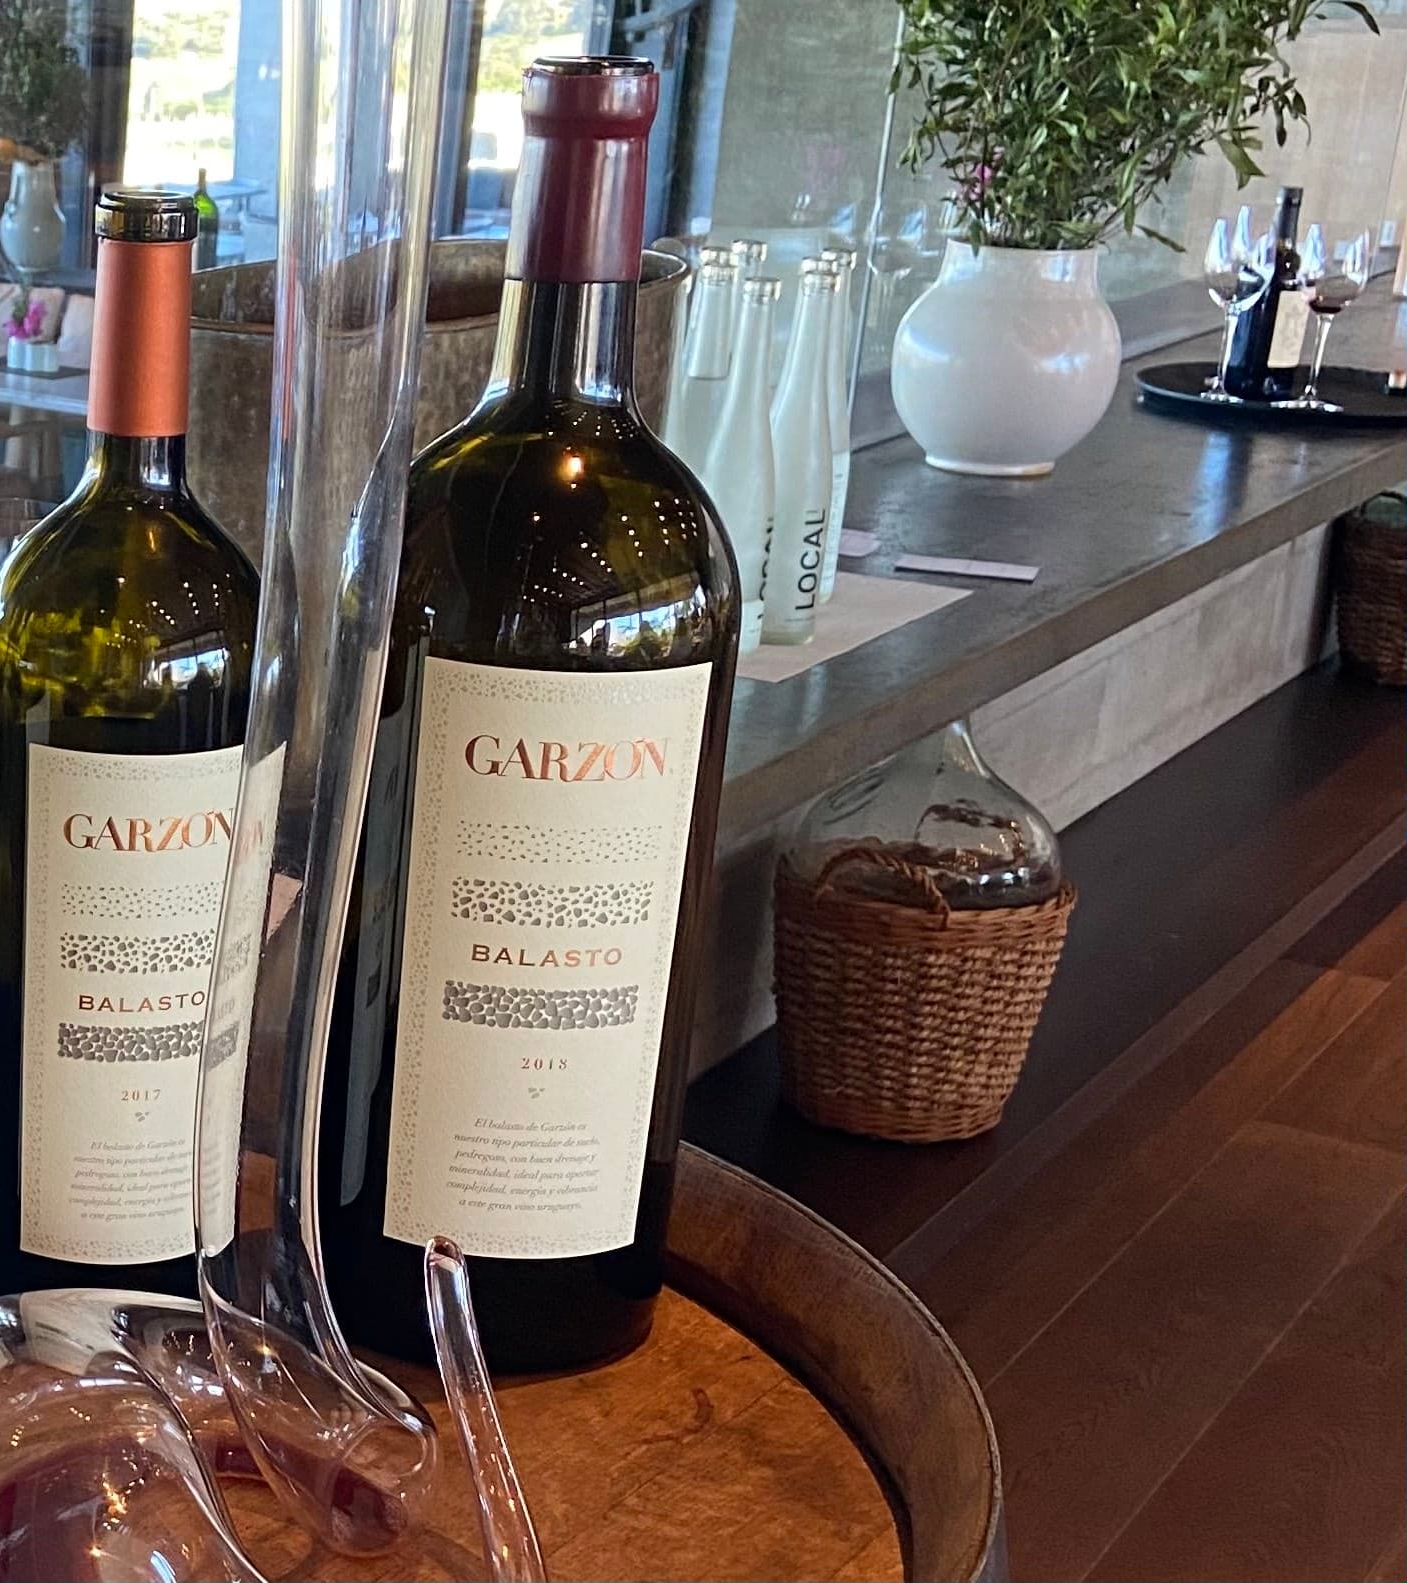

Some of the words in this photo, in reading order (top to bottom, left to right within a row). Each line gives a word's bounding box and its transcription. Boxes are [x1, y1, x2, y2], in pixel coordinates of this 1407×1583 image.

[795, 508, 826, 611] LOCAL
[465, 734, 670, 783] GARZÓN
[63, 807, 235, 852] GARZÓN
[470, 943, 623, 968] BALASTO
[78, 990, 206, 1013] BALASTO
[521, 1056, 568, 1071] 2018
[121, 1089, 162, 1103] 2017
[474, 1118, 487, 1128] El
[526, 1122, 538, 1131] de
[454, 1133, 490, 1144] nuestro
[492, 1137, 510, 1148] tipo
[512, 1138, 562, 1149] particular
[563, 1137, 575, 1147] de
[510, 1155, 527, 1163] con
[514, 1169, 539, 1180] ideal
[487, 1201, 512, 1211] gran
